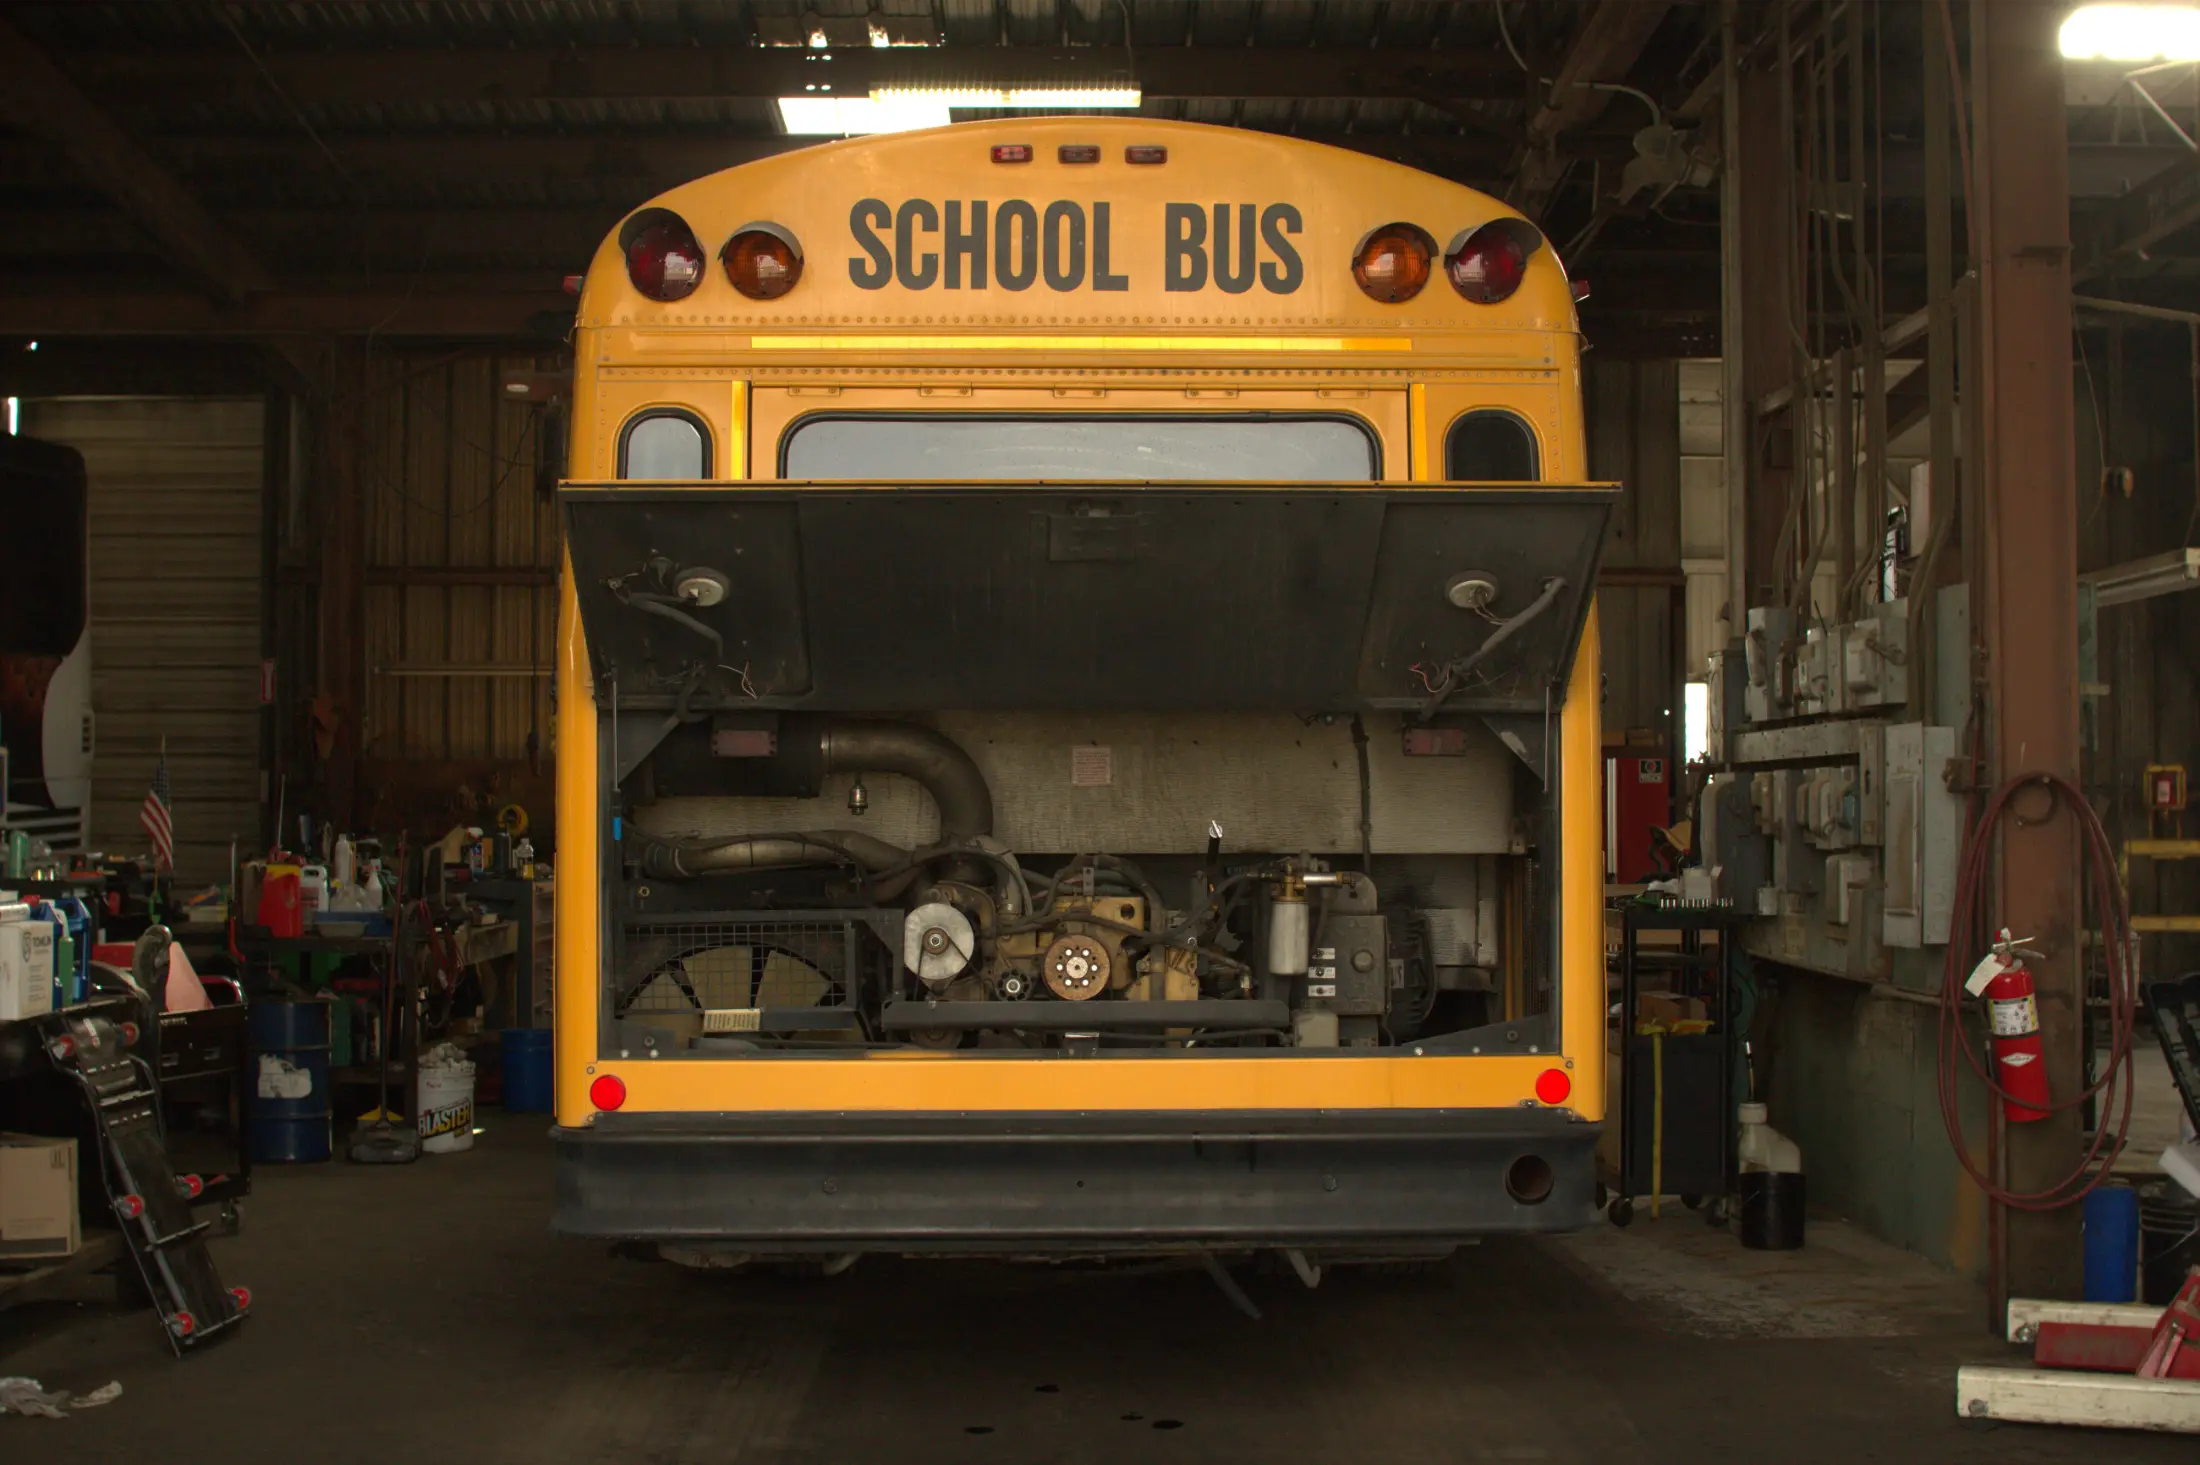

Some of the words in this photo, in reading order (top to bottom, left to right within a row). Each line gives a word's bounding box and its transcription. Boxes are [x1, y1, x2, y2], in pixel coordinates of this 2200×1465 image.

[848, 198, 1128, 291] SCHOOL
[1165, 204, 1302, 293] BUS
[418, 1101, 470, 1137] BLASTER
